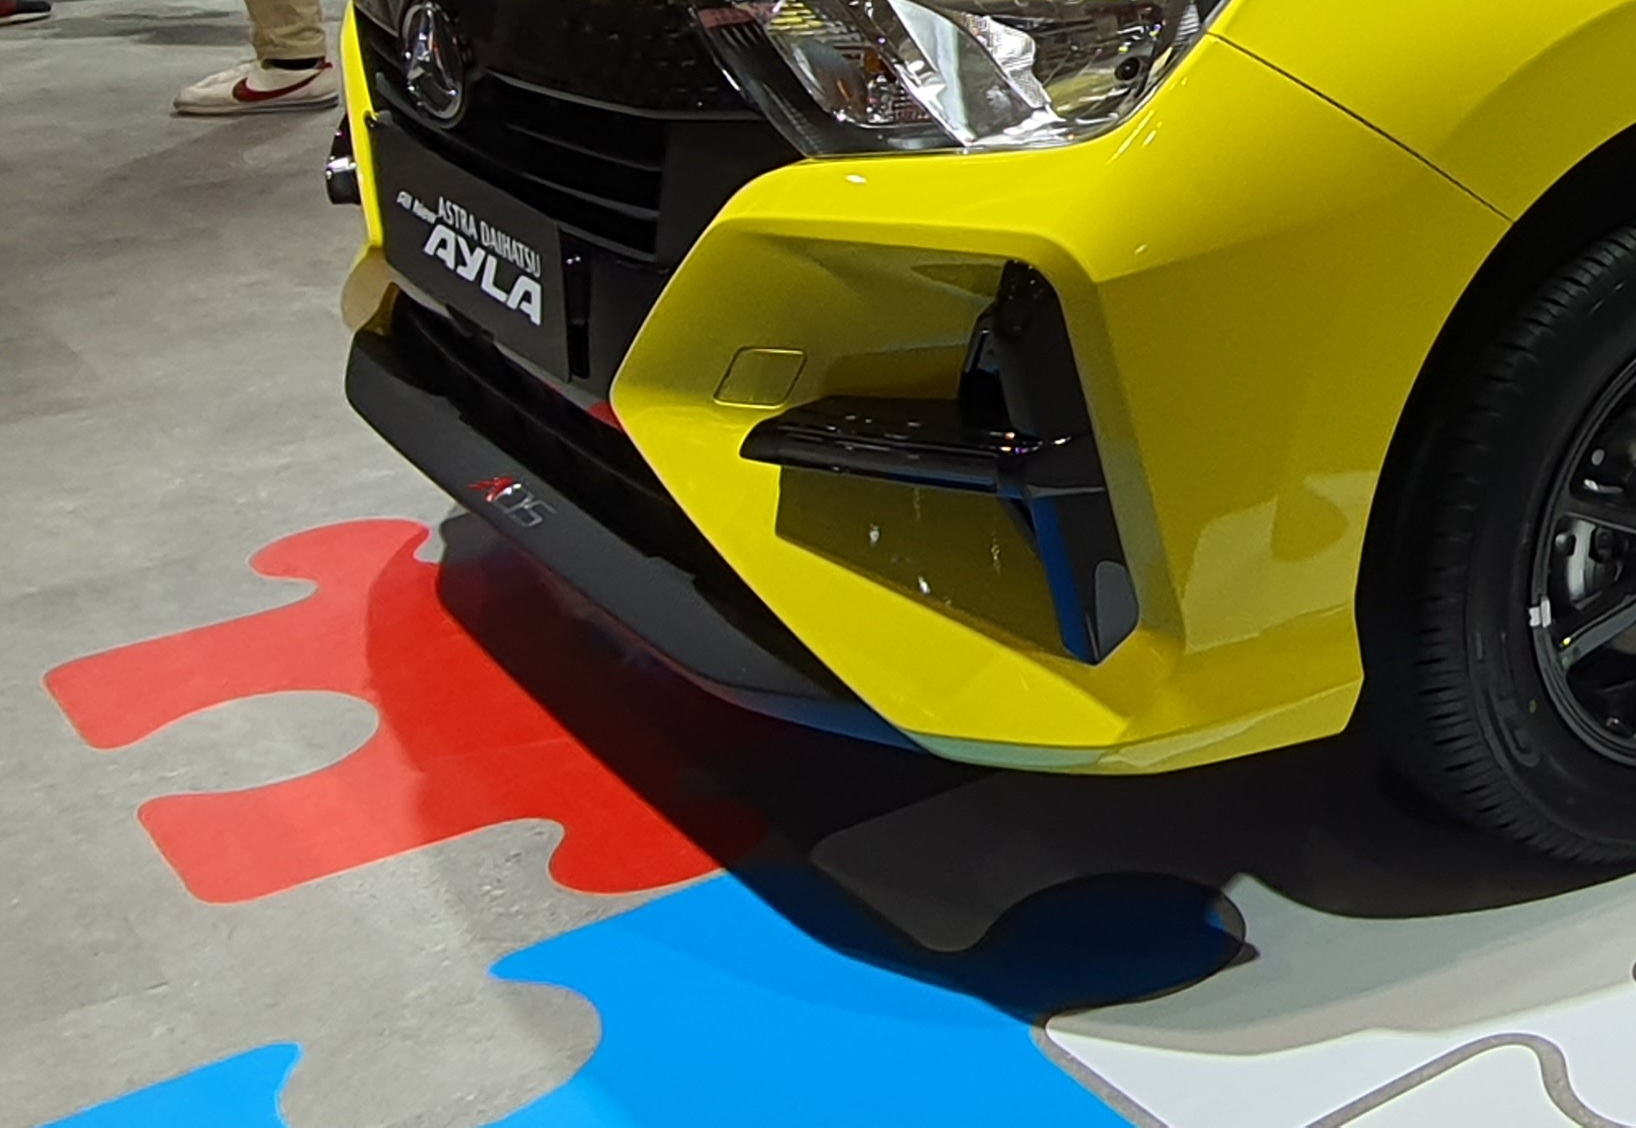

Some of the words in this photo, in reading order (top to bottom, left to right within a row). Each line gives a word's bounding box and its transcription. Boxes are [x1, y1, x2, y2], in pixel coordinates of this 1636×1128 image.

[423, 224, 542, 326] AYLA
[437, 196, 478, 240] ASTRA
[480, 220, 541, 278] DAIHATSU
